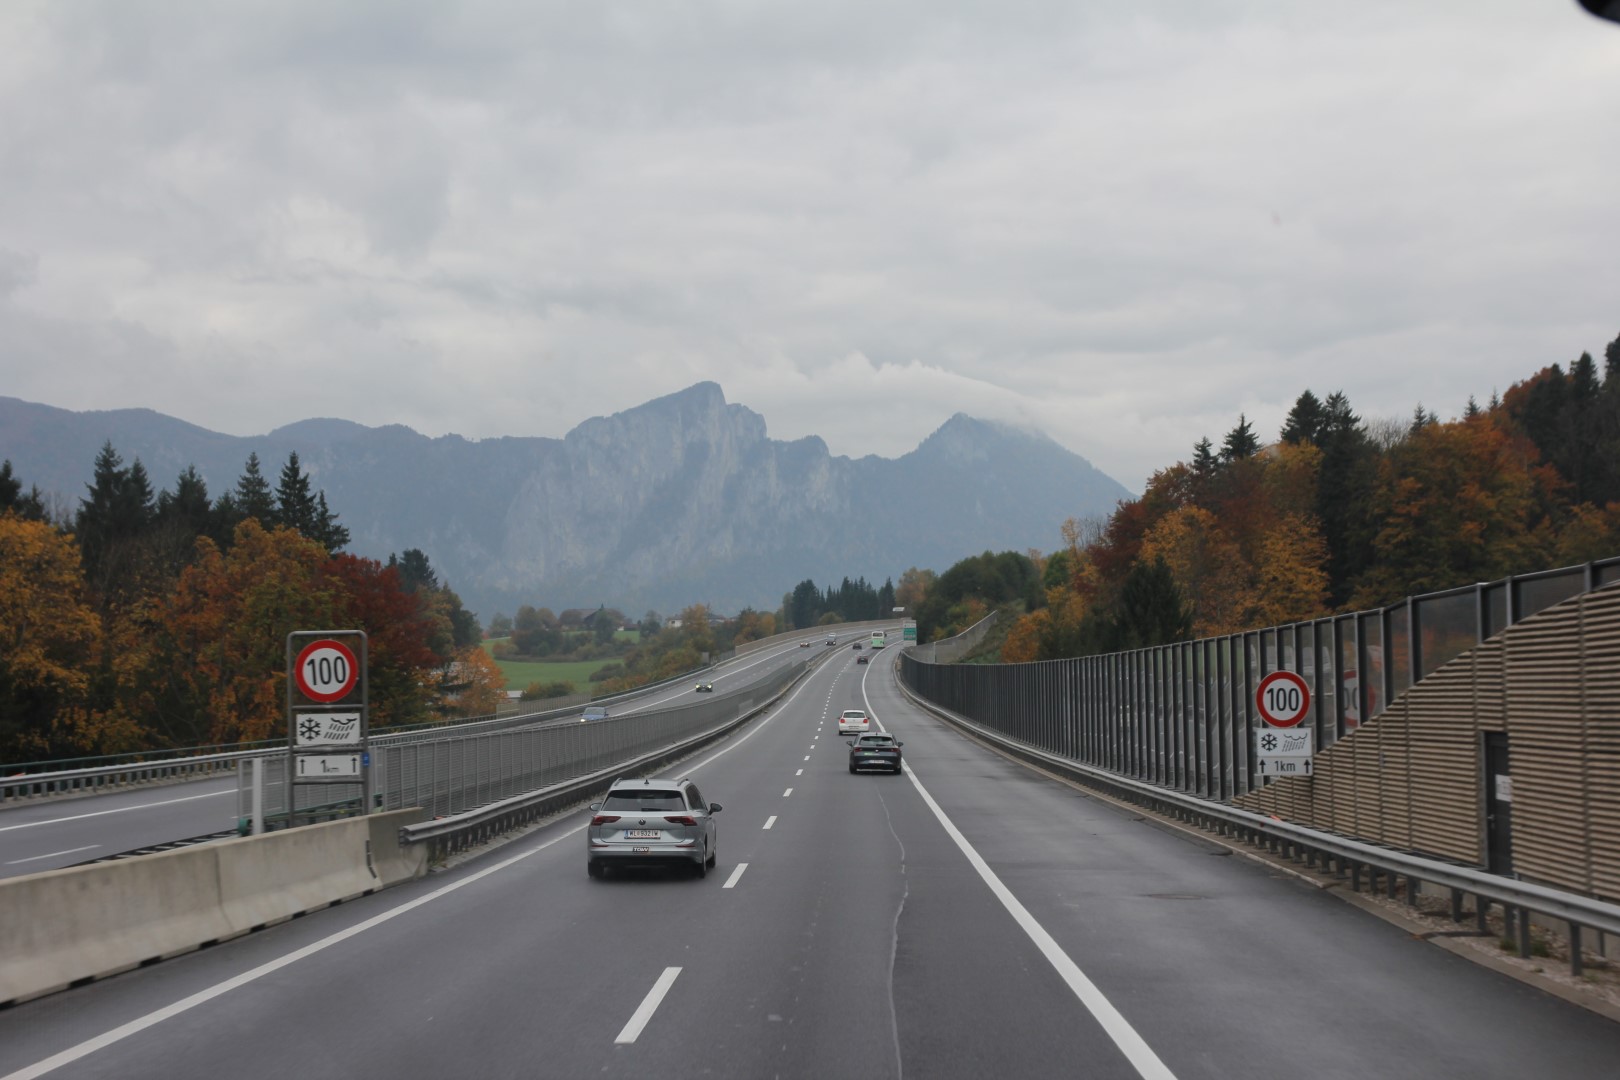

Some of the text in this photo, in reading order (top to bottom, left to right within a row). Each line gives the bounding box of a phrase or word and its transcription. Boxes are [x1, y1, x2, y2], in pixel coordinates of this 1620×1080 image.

[306, 656, 347, 686] 100
[1266, 687, 1300, 712] 100
[1274, 760, 1296, 772] 1km
